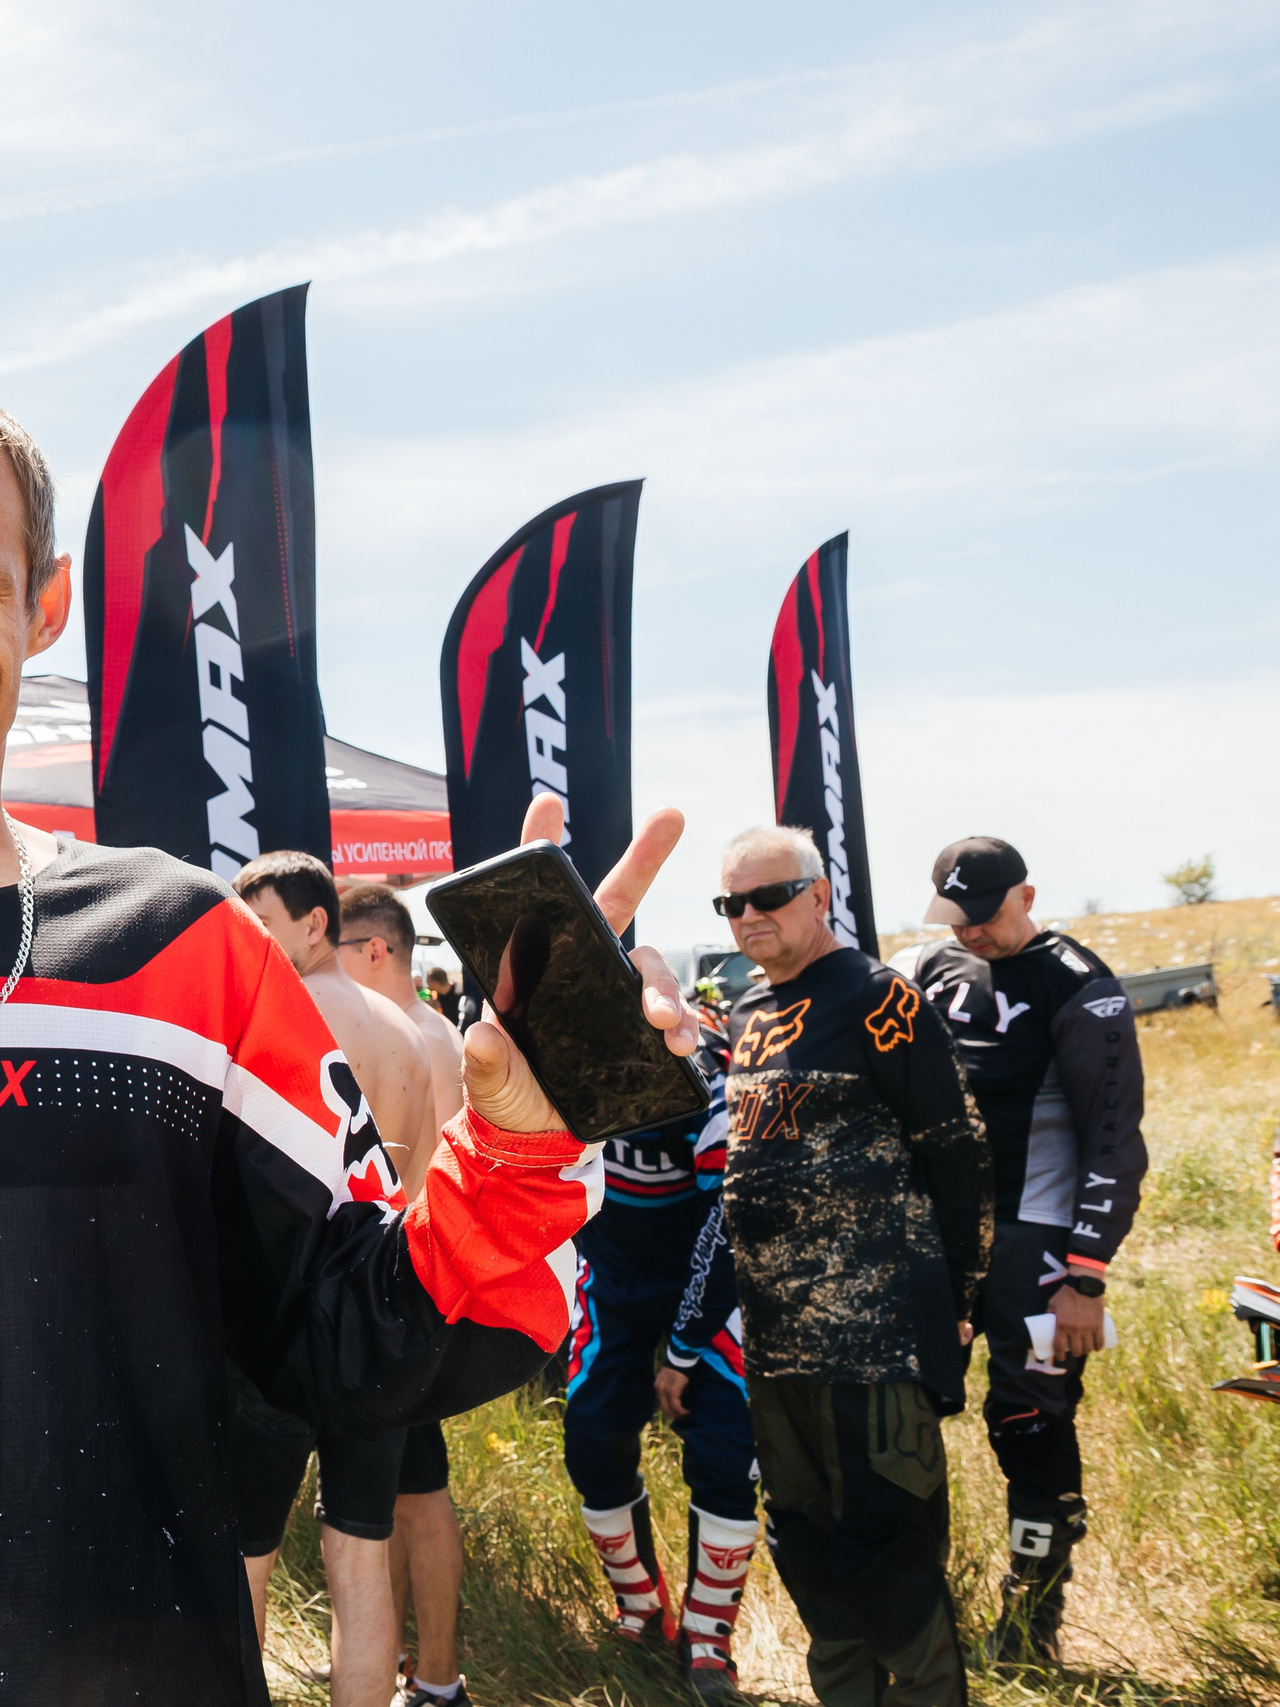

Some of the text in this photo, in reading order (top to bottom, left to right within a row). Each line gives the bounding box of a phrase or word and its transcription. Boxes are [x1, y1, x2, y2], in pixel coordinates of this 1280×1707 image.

[183, 521, 261, 880] MAX
[344, 838, 429, 863] УСИЛЕННОЙ
[1072, 1171, 1117, 1240] FLY
